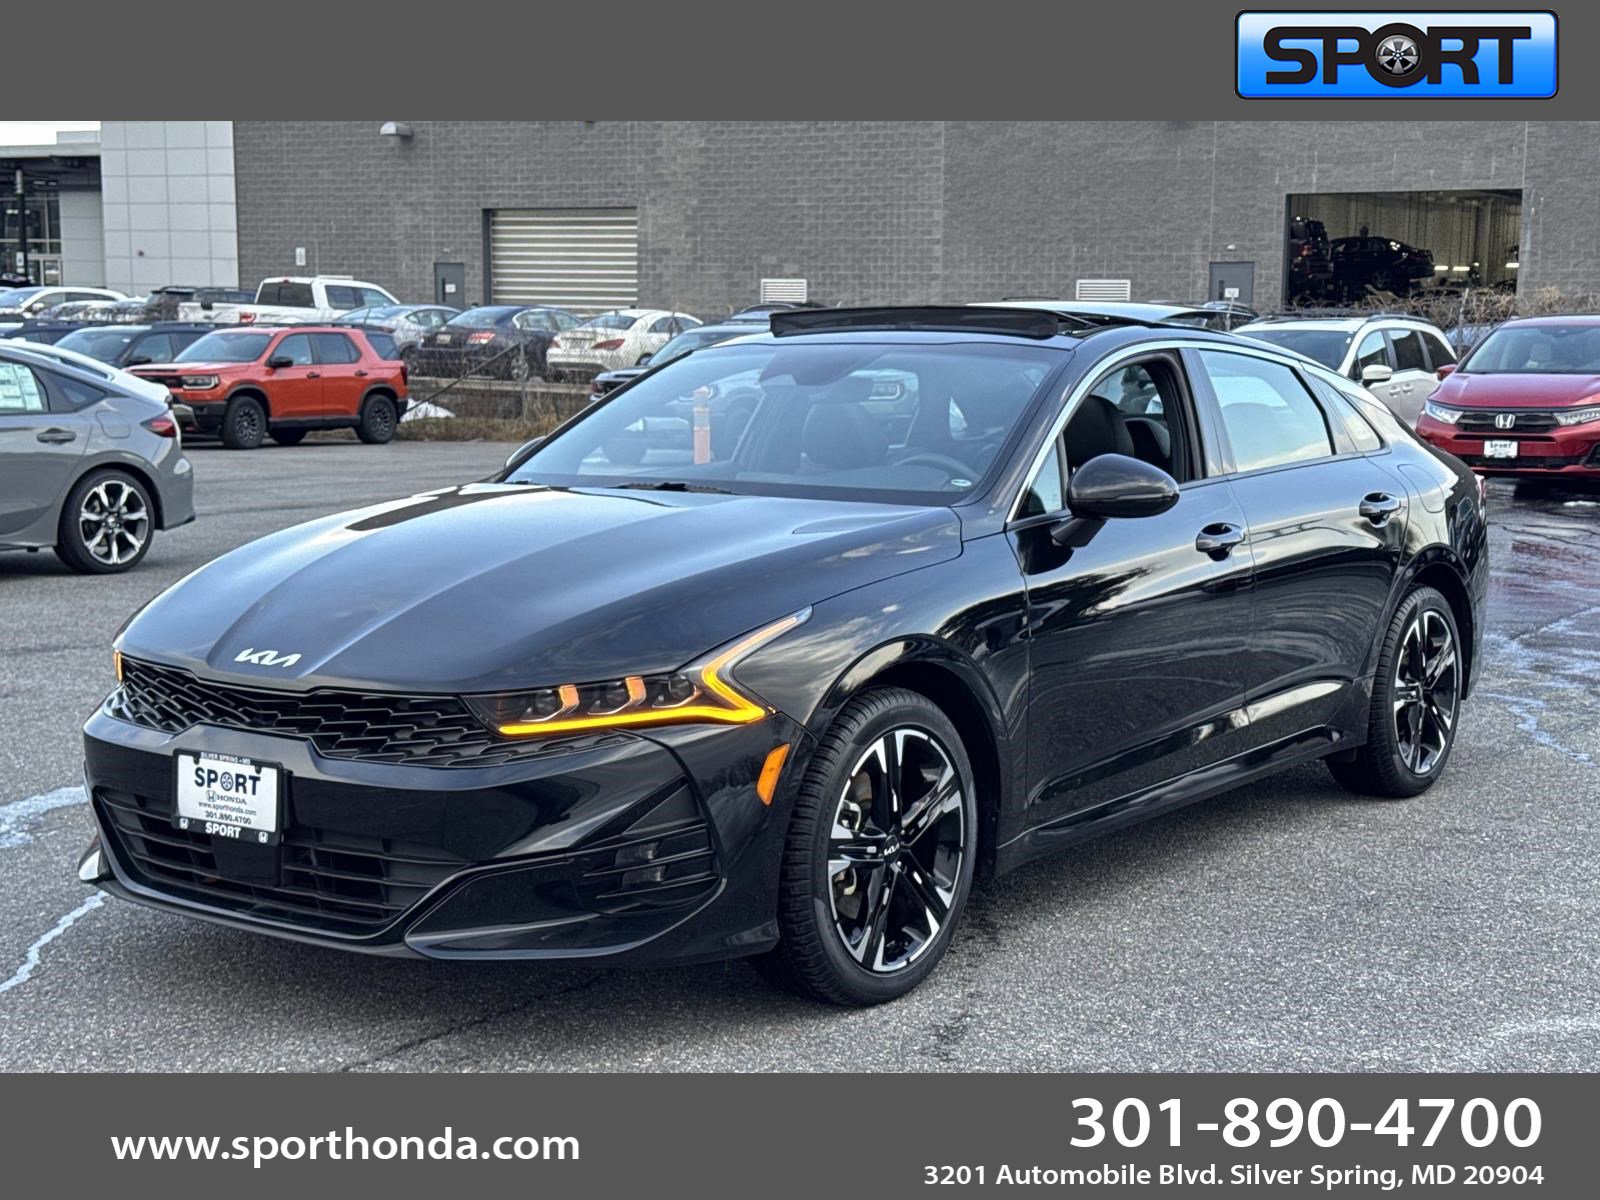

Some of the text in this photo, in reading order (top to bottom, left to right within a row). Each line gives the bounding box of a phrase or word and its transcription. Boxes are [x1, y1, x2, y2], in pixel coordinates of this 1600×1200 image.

[194, 766, 261, 796] SPORT
[216, 794, 247, 805] HONDA
[205, 822, 241, 838] SPORT
